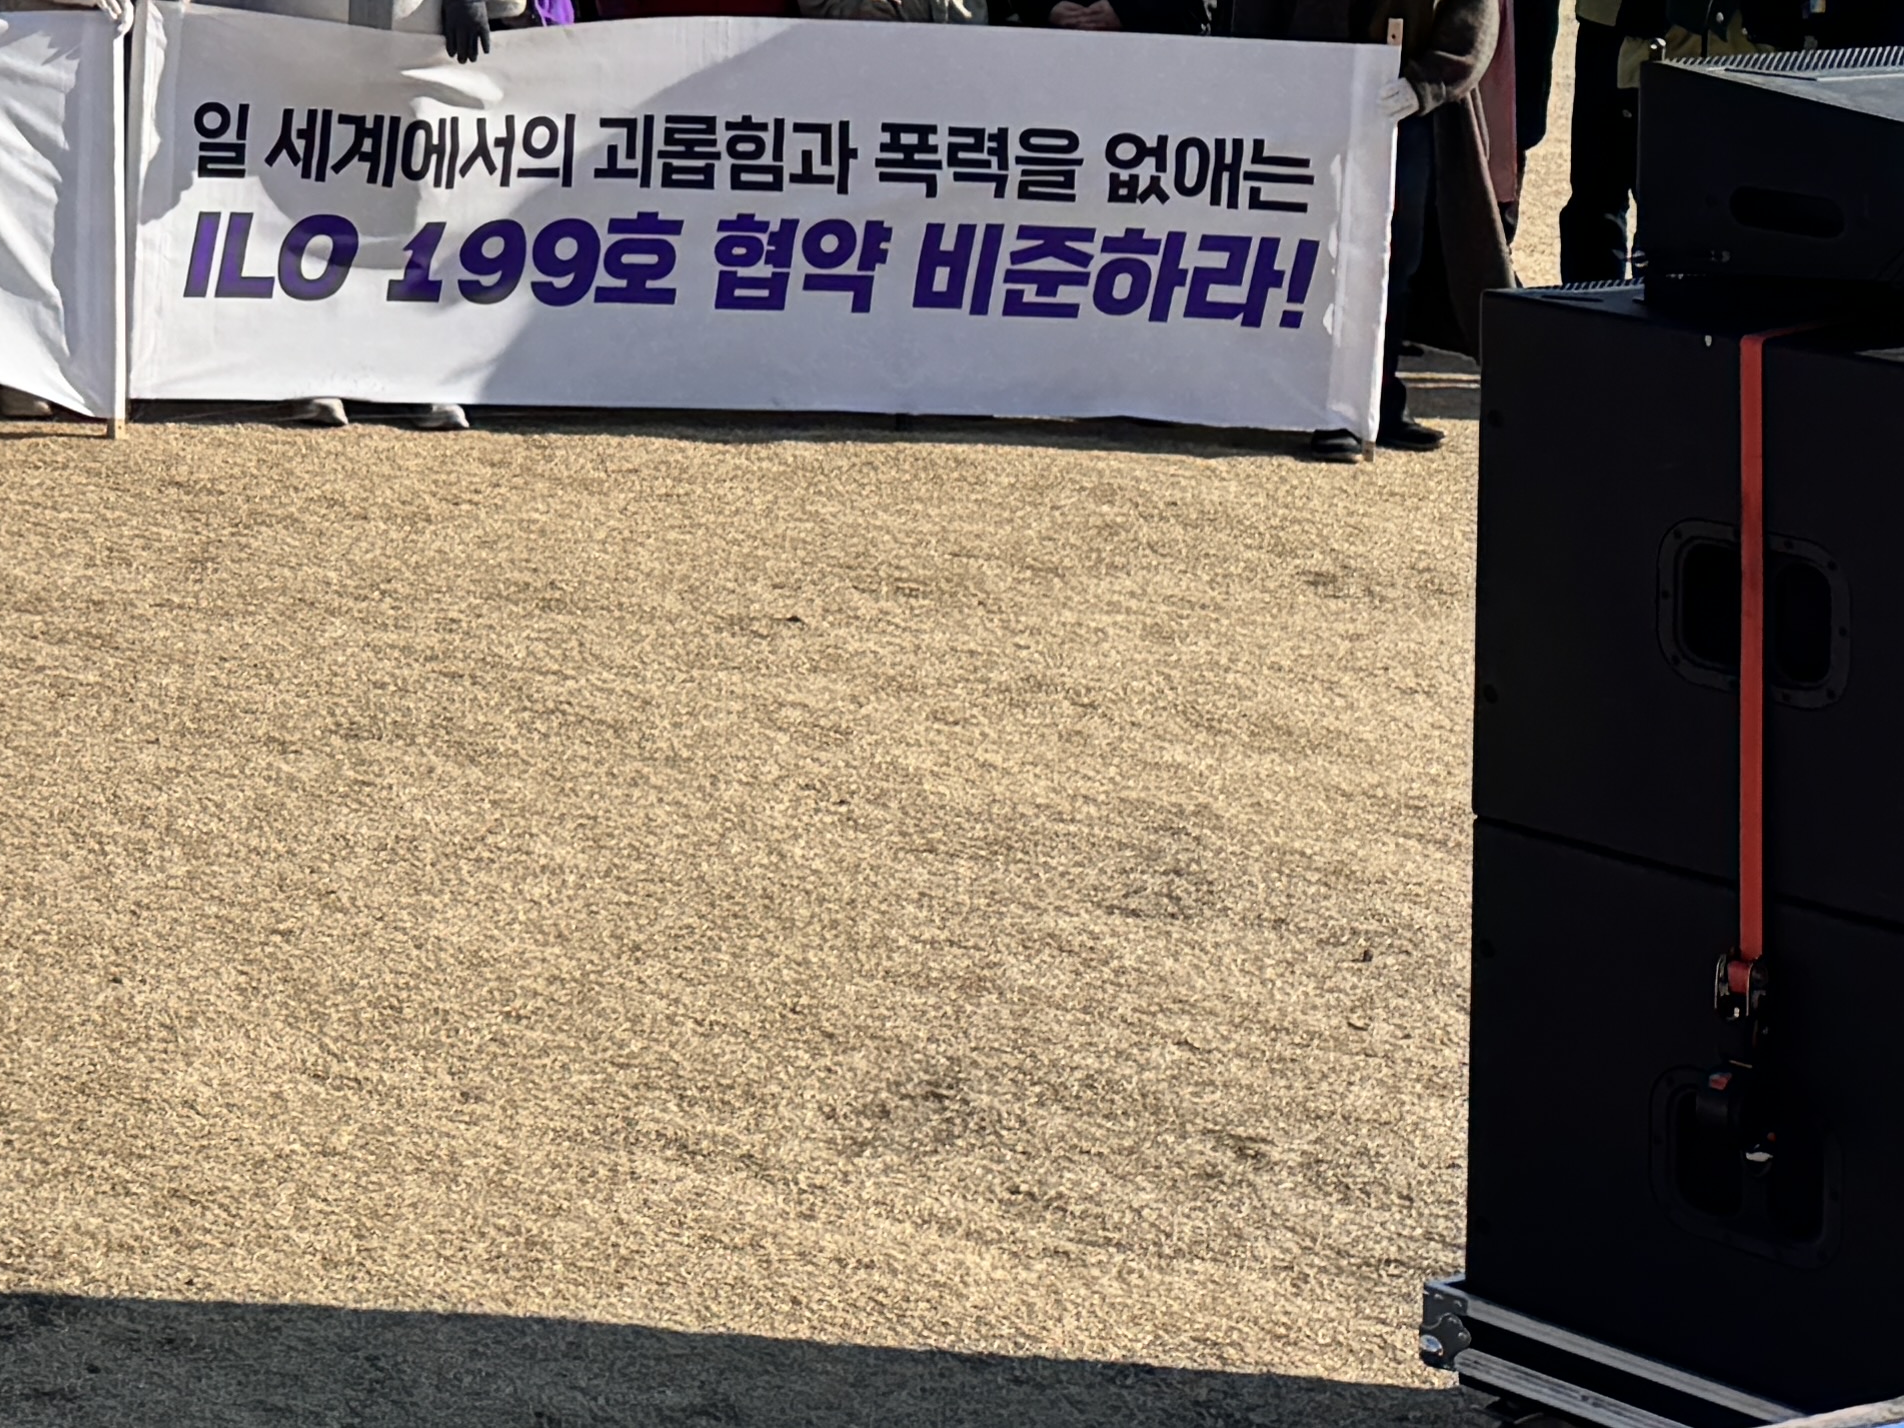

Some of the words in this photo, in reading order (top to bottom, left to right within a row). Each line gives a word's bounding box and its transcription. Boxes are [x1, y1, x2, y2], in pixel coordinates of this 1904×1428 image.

[193, 103, 251, 180] 일
[265, 108, 577, 191] 세계에서의
[593, 115, 858, 196] 괴롭힘과
[873, 121, 1084, 204] 폭력을
[1104, 130, 1315, 214] 없애는
[184, 211, 358, 302] ILO
[387, 210, 685, 307] 199호
[713, 213, 888, 316] 협약
[912, 222, 1319, 331] 비준하라!
